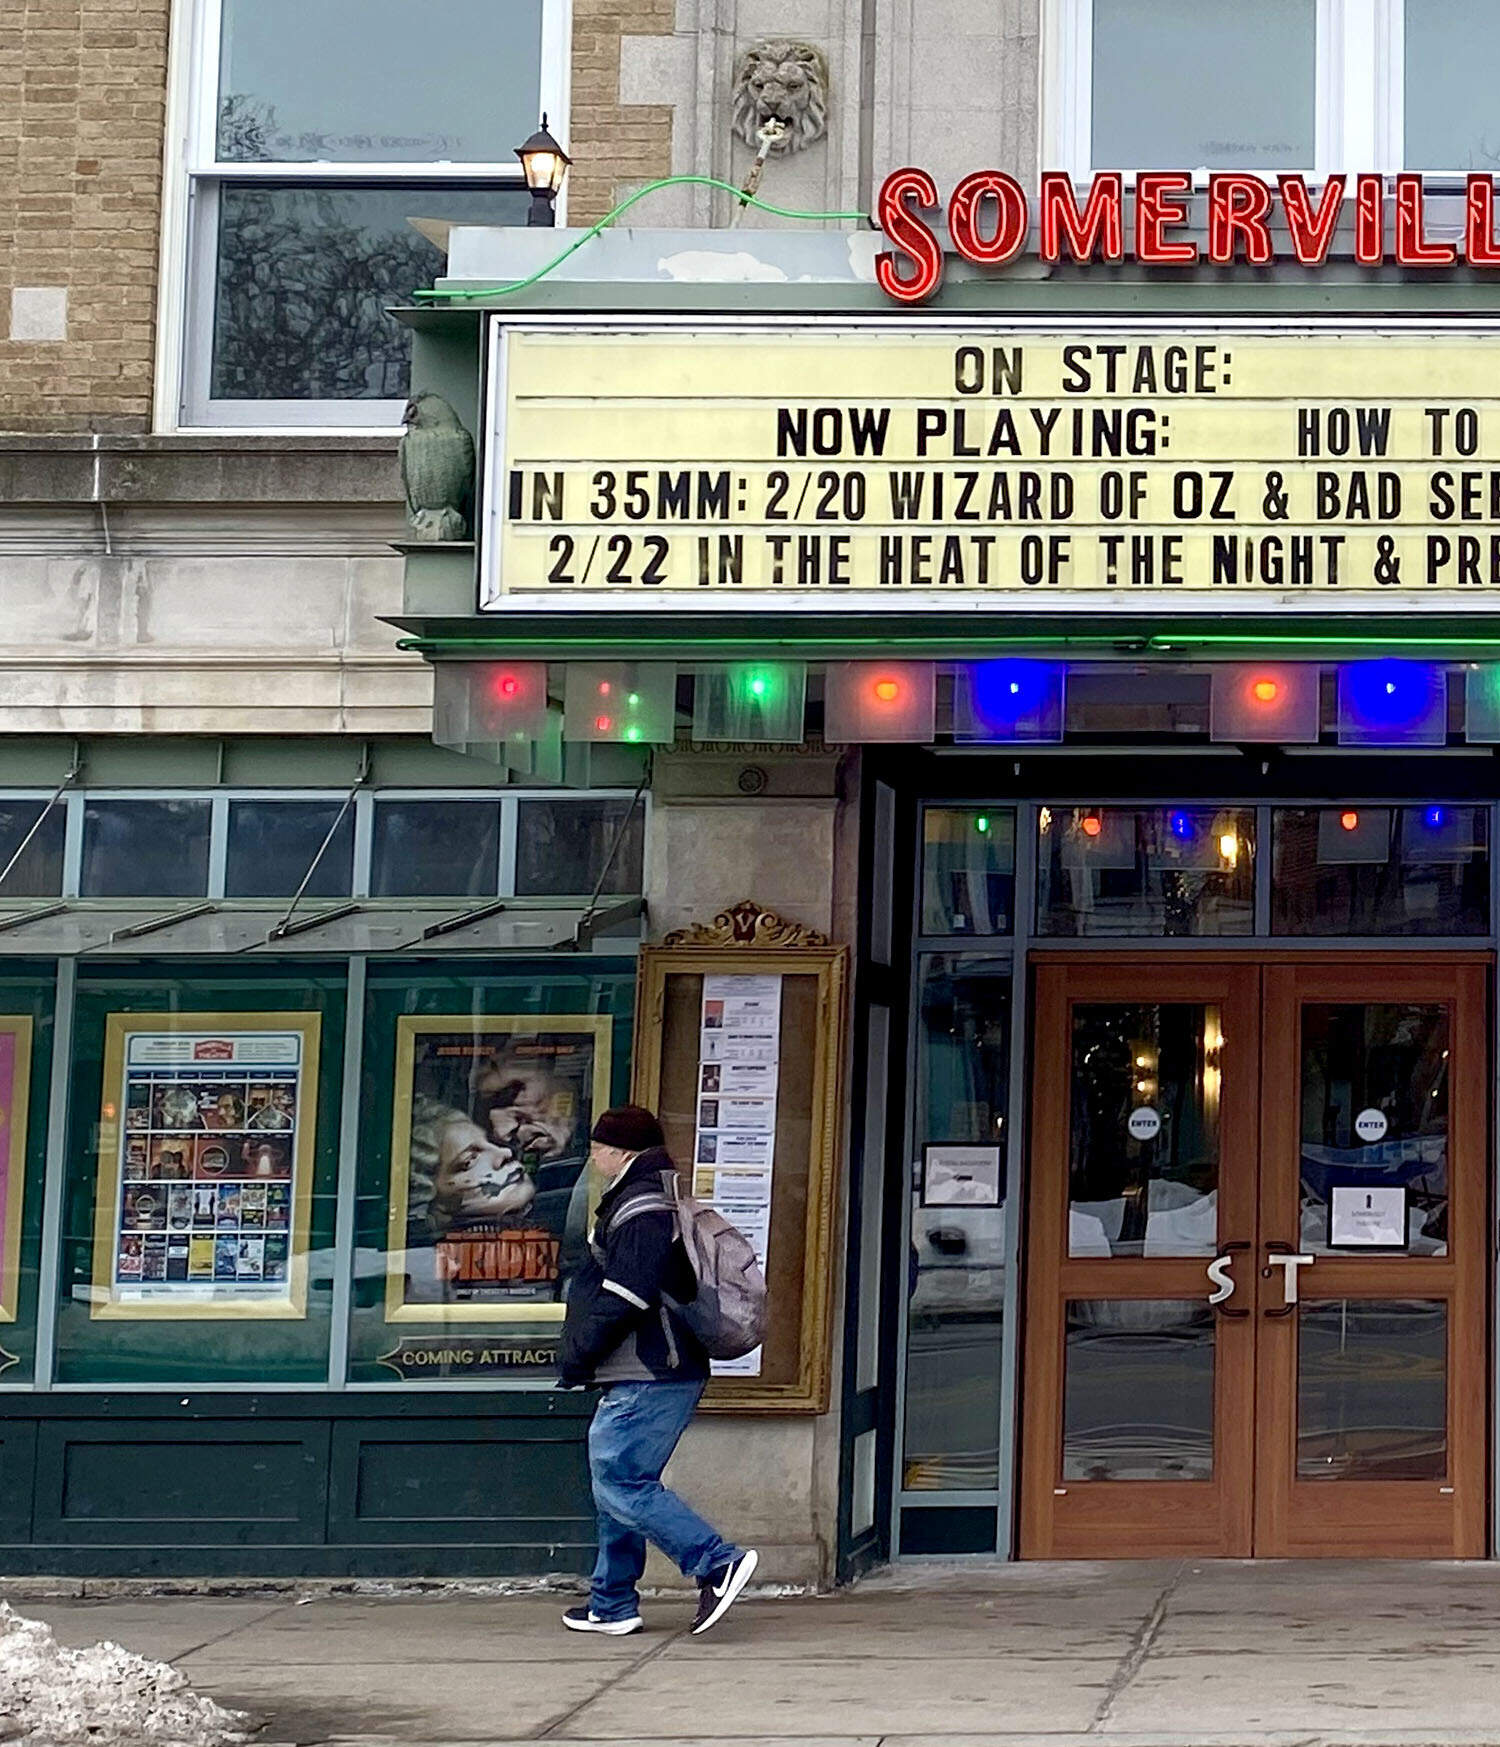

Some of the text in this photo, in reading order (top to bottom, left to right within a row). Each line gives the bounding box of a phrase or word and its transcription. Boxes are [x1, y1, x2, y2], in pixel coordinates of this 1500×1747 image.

[955, 346, 1022, 395] ON
[1062, 346, 1232, 395] STAGE:
[777, 408, 890, 458] NOW
[917, 408, 1170, 458] PLAYING:
[1298, 408, 1391, 458] HOW
[1425, 408, 1478, 458] TO
[508, 470, 564, 522] IN
[590, 470, 748, 522] 35MM:
[766, 470, 866, 522] 2/20
[889, 470, 1074, 522] WIZARD
[1100, 470, 1148, 522] OF
[1173, 470, 1236, 522] OZ
[1262, 470, 1289, 522] &
[1316, 470, 1401, 522] BAD
[548, 534, 671, 586] 2/22
[698, 534, 744, 586] IN
[765, 534, 850, 586] THE
[879, 534, 990, 586] HEAT
[1020, 534, 1071, 586] OF
[1106, 534, 1184, 586] THE
[1211, 534, 1345, 586] NIGHT
[1374, 534, 1401, 586] &
[1131, 1119, 1159, 1128] ENTER
[1358, 1121, 1385, 1129] ENTER
[402, 1350, 557, 1366] COMING ATTRACT
